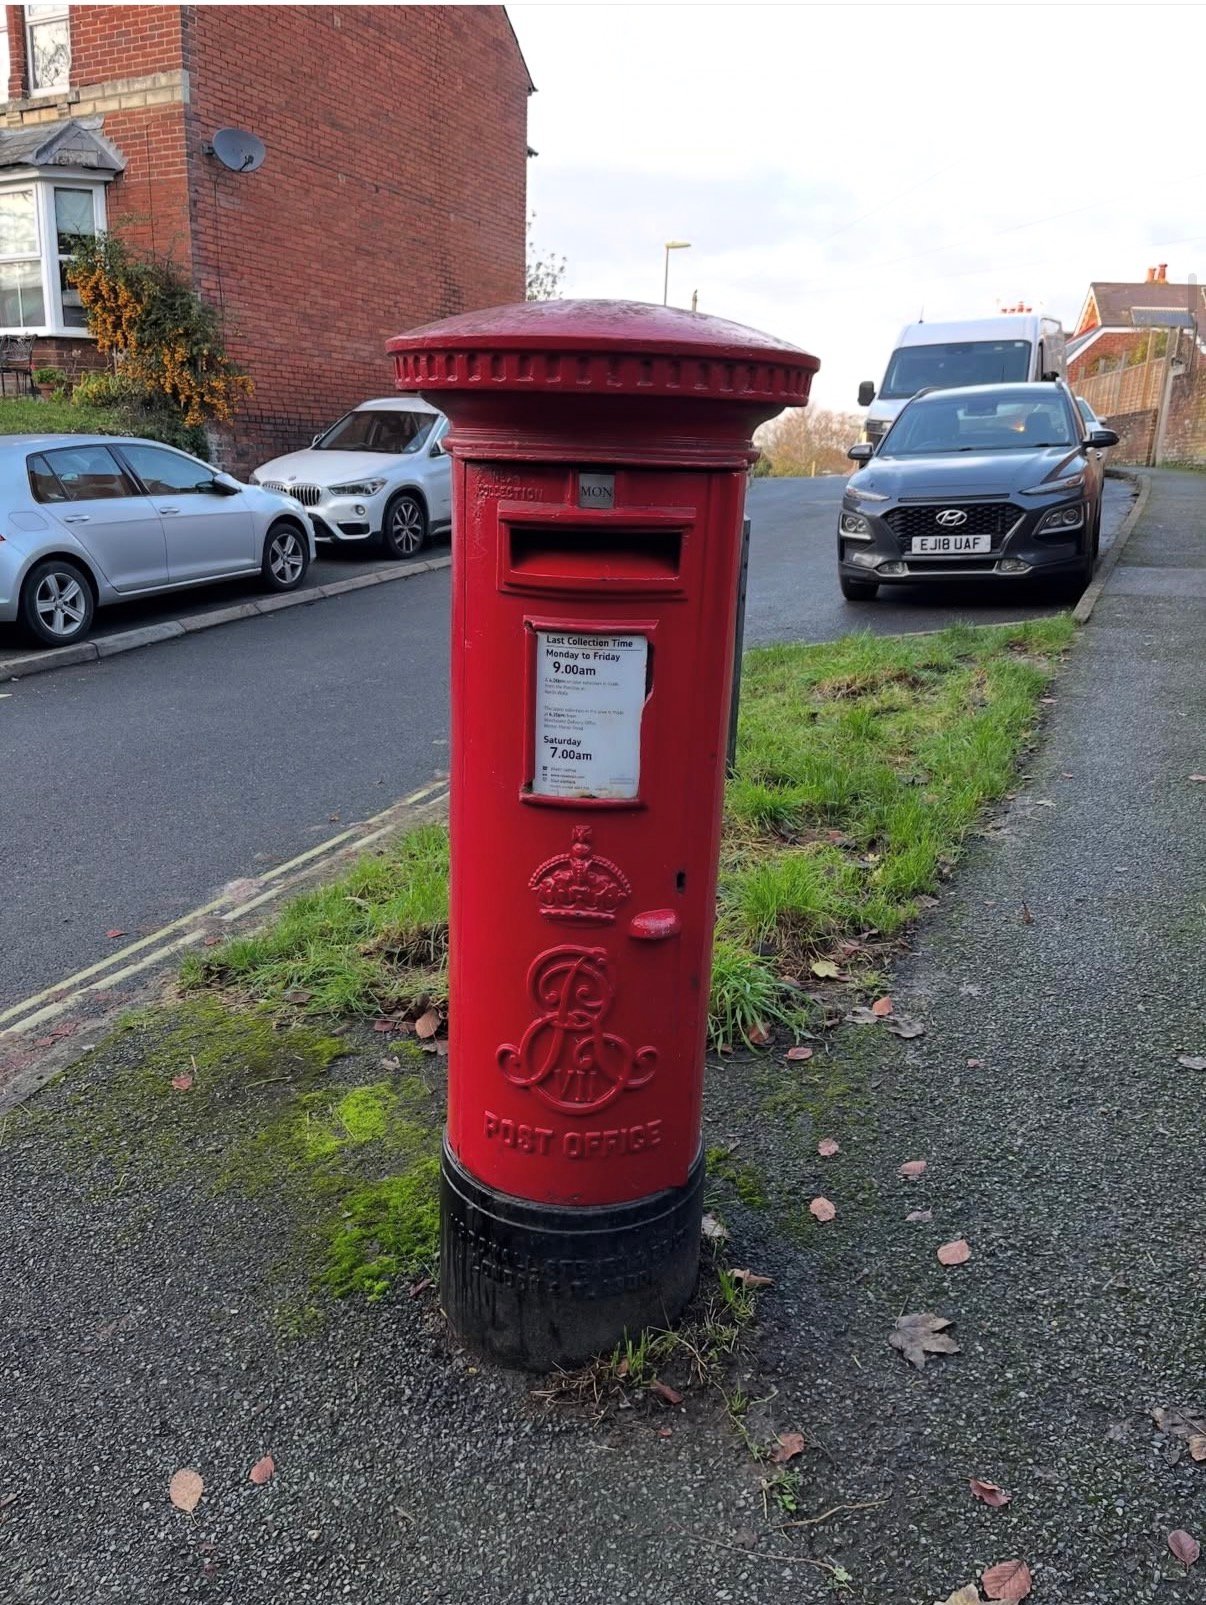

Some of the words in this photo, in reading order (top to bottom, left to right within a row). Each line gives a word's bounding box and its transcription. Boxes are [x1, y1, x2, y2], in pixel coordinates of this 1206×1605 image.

[581, 486, 612, 498] MON
[920, 538, 950, 551] EJ18
[954, 537, 982, 550] UAF
[546, 635, 565, 645] Last
[567, 637, 609, 647] Collection
[612, 639, 633, 648] Time
[546, 649, 579, 660] Monday
[582, 652, 591, 660] to
[593, 652, 621, 662] Friday
[553, 661, 596, 676] 9.00am
[543, 735, 582, 747] Saturday
[550, 746, 592, 761] 7.00am
[483, 1109, 553, 1156] POST
[563, 1118, 663, 1159] OFFICE
